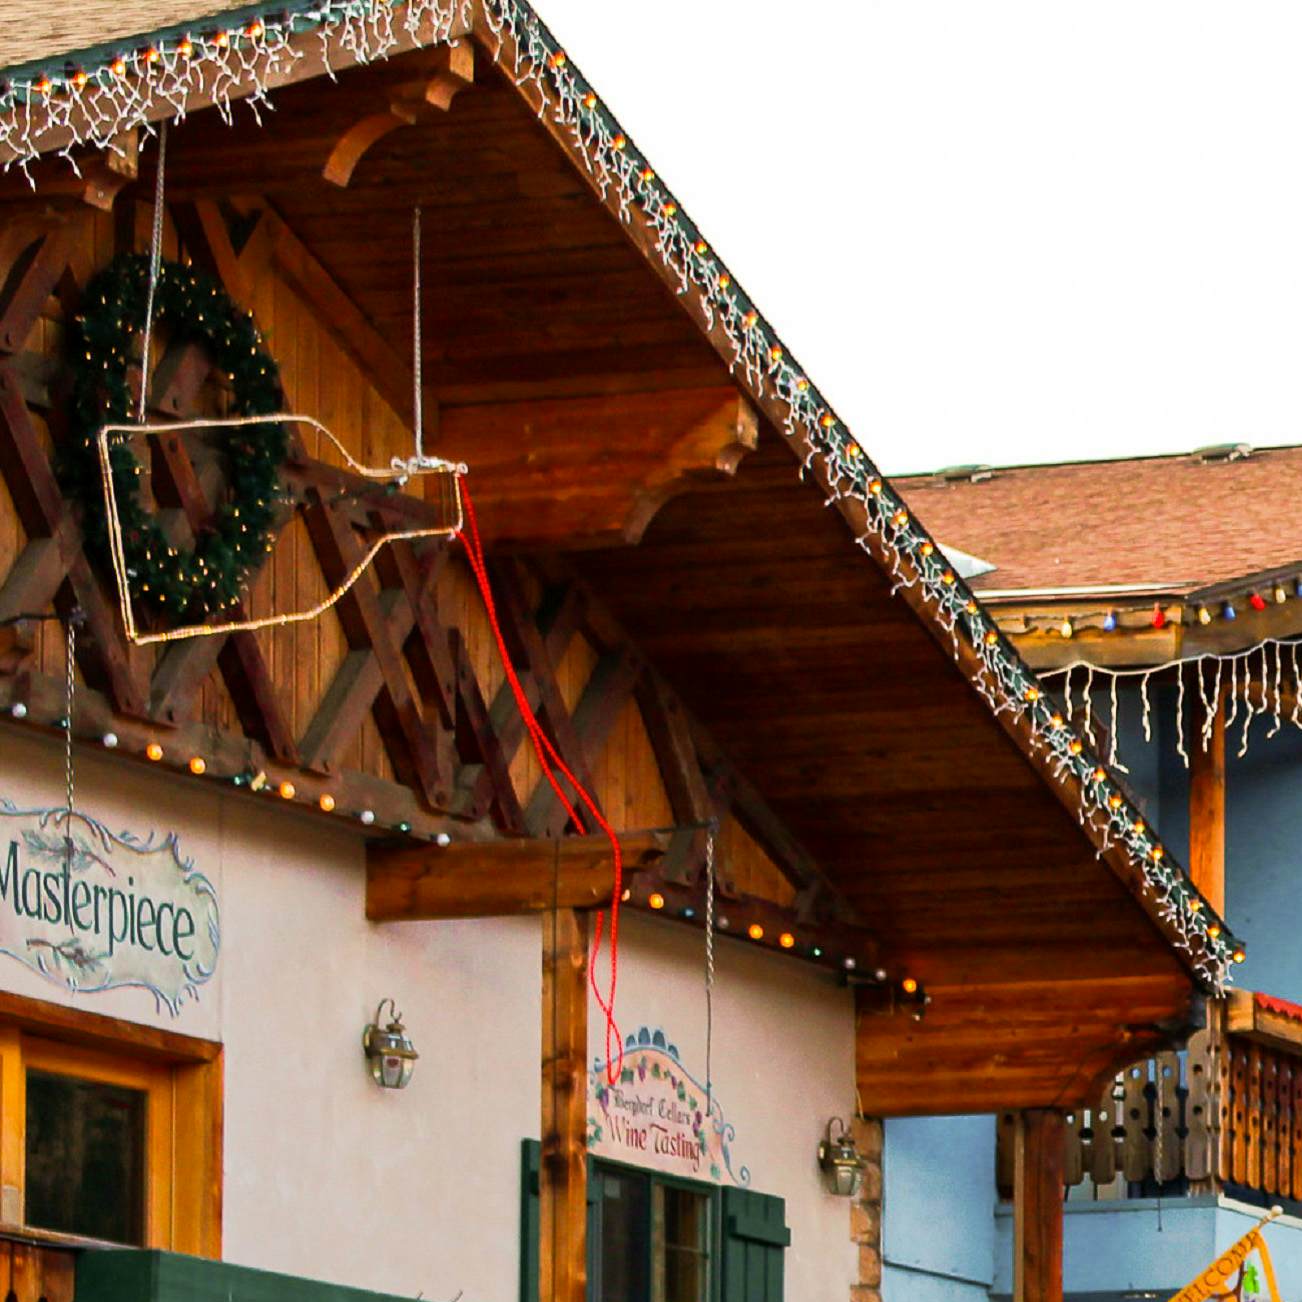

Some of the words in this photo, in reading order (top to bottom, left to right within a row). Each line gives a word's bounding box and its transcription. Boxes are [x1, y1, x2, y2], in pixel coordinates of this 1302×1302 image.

[0, 840, 196, 961] Masterpiece
[658, 1098, 691, 1125] Cellars
[604, 1113, 648, 1151] Wine
[650, 1123, 701, 1173] Tasting
